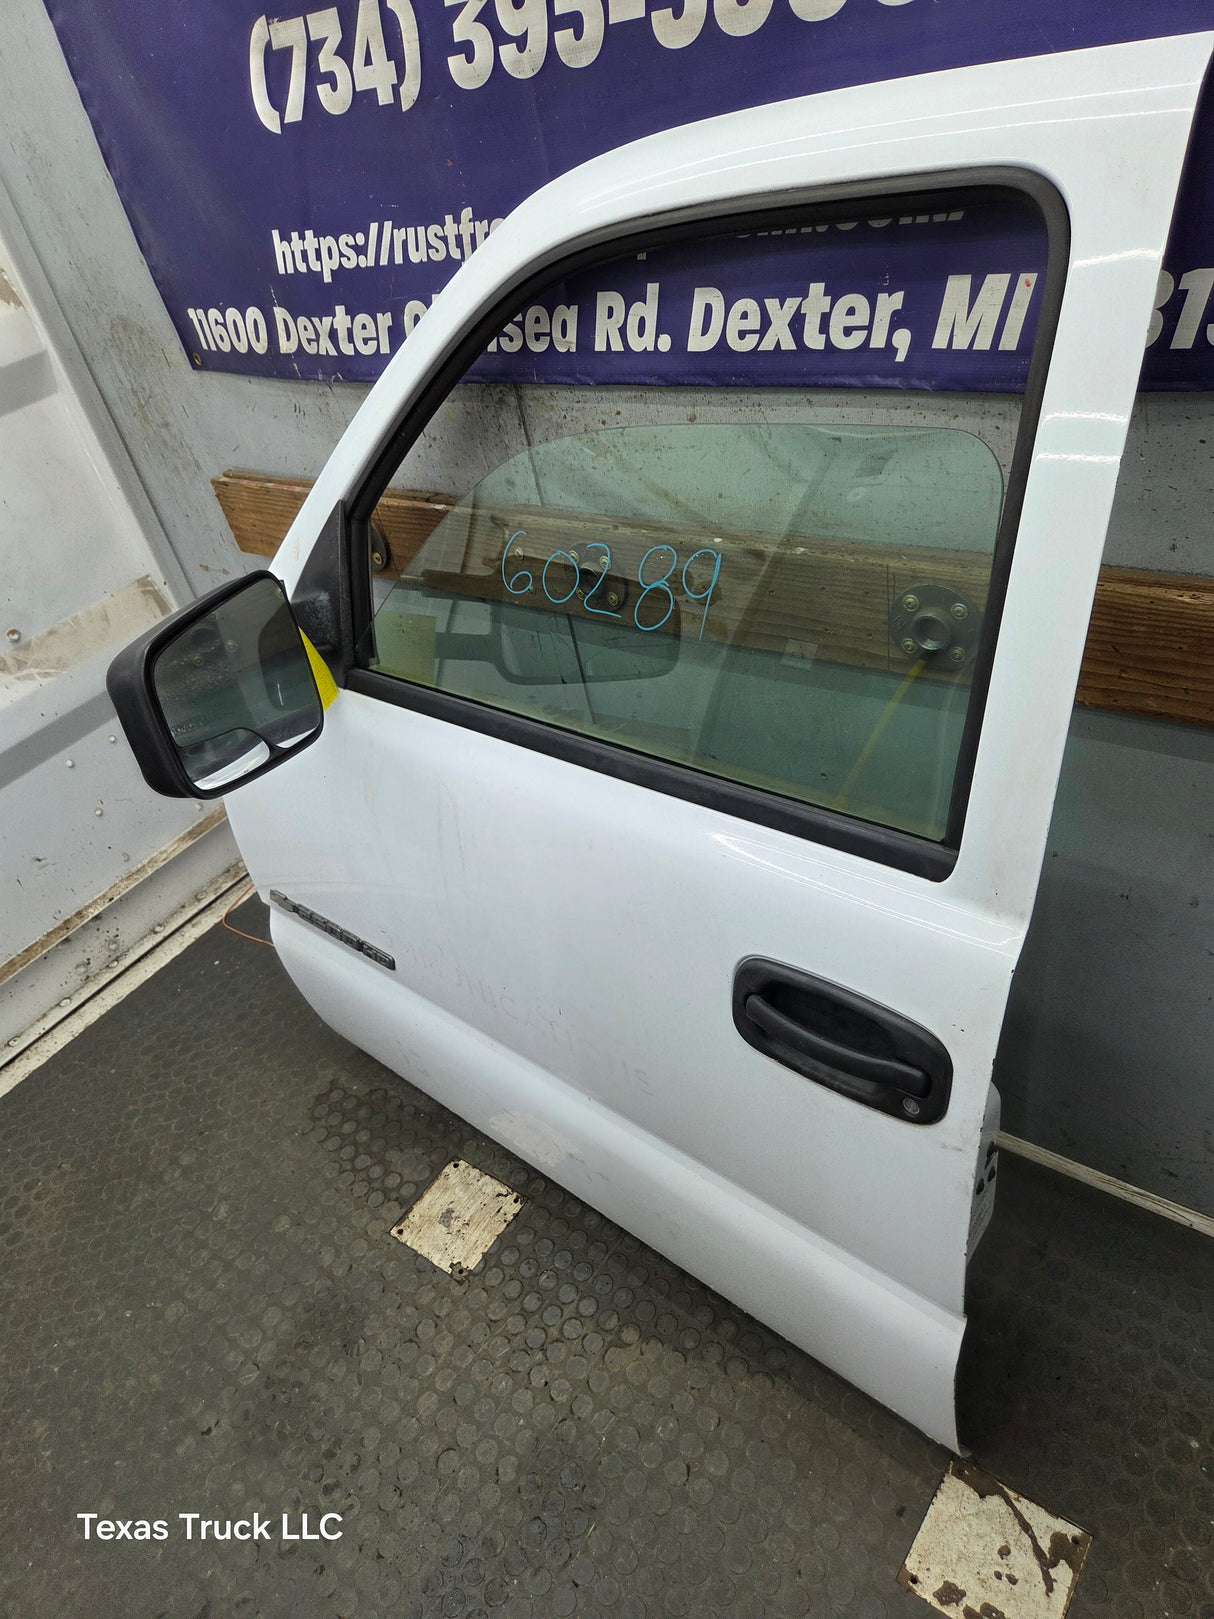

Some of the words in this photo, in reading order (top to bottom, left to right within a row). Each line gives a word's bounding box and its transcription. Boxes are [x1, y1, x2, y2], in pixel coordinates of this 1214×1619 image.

[249, 0, 421, 134] (734)
[271, 206, 506, 283] https://rustfr
[187, 306, 268, 355] 11600
[273, 304, 395, 356] Dexter
[594, 282, 672, 353] Rd.
[686, 281, 912, 362] Dexter,
[930, 272, 1039, 351] MI
[501, 530, 722, 641] 60289
